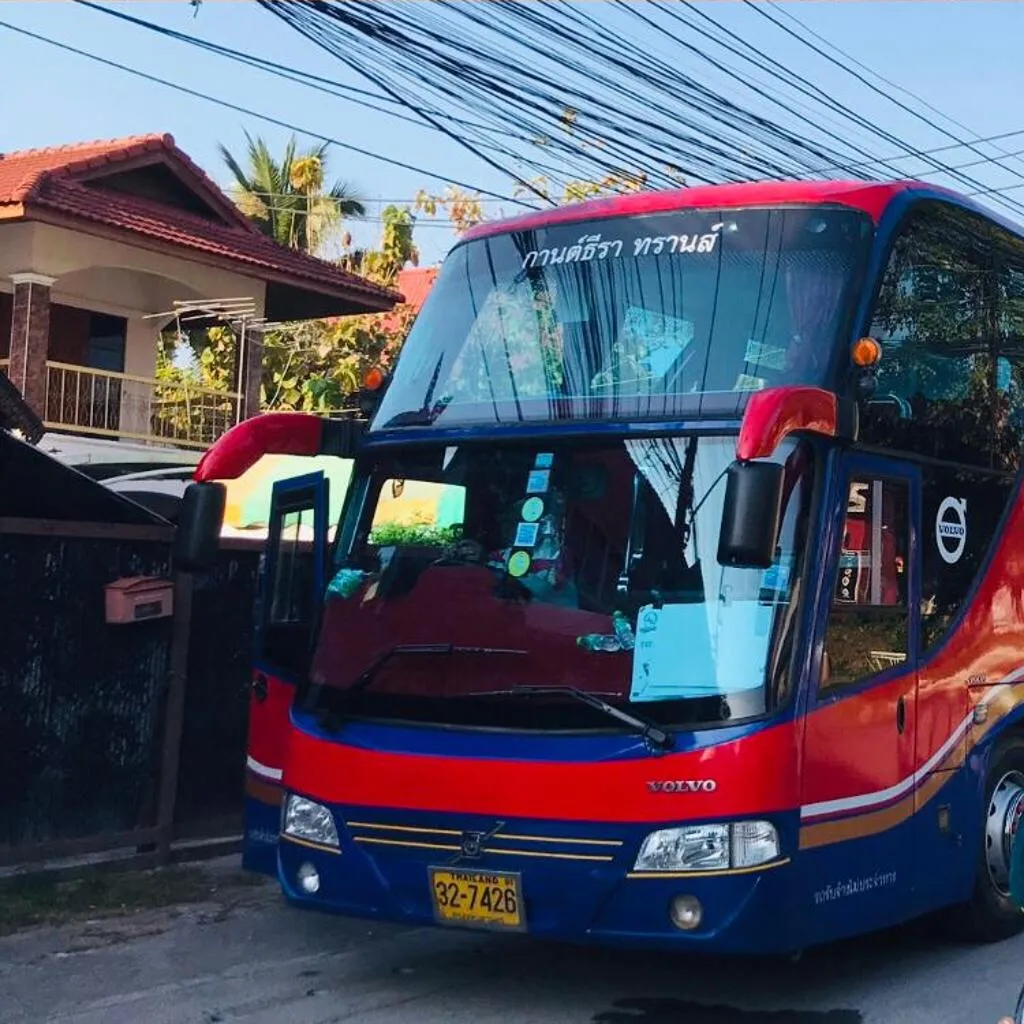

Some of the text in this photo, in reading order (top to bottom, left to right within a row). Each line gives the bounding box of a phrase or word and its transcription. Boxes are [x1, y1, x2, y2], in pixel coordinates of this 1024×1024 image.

[522, 222, 724, 268] กานต์ธีรา ทรานส์
[645, 779, 717, 792] VOLVO
[436, 881, 517, 914] 32-7426
